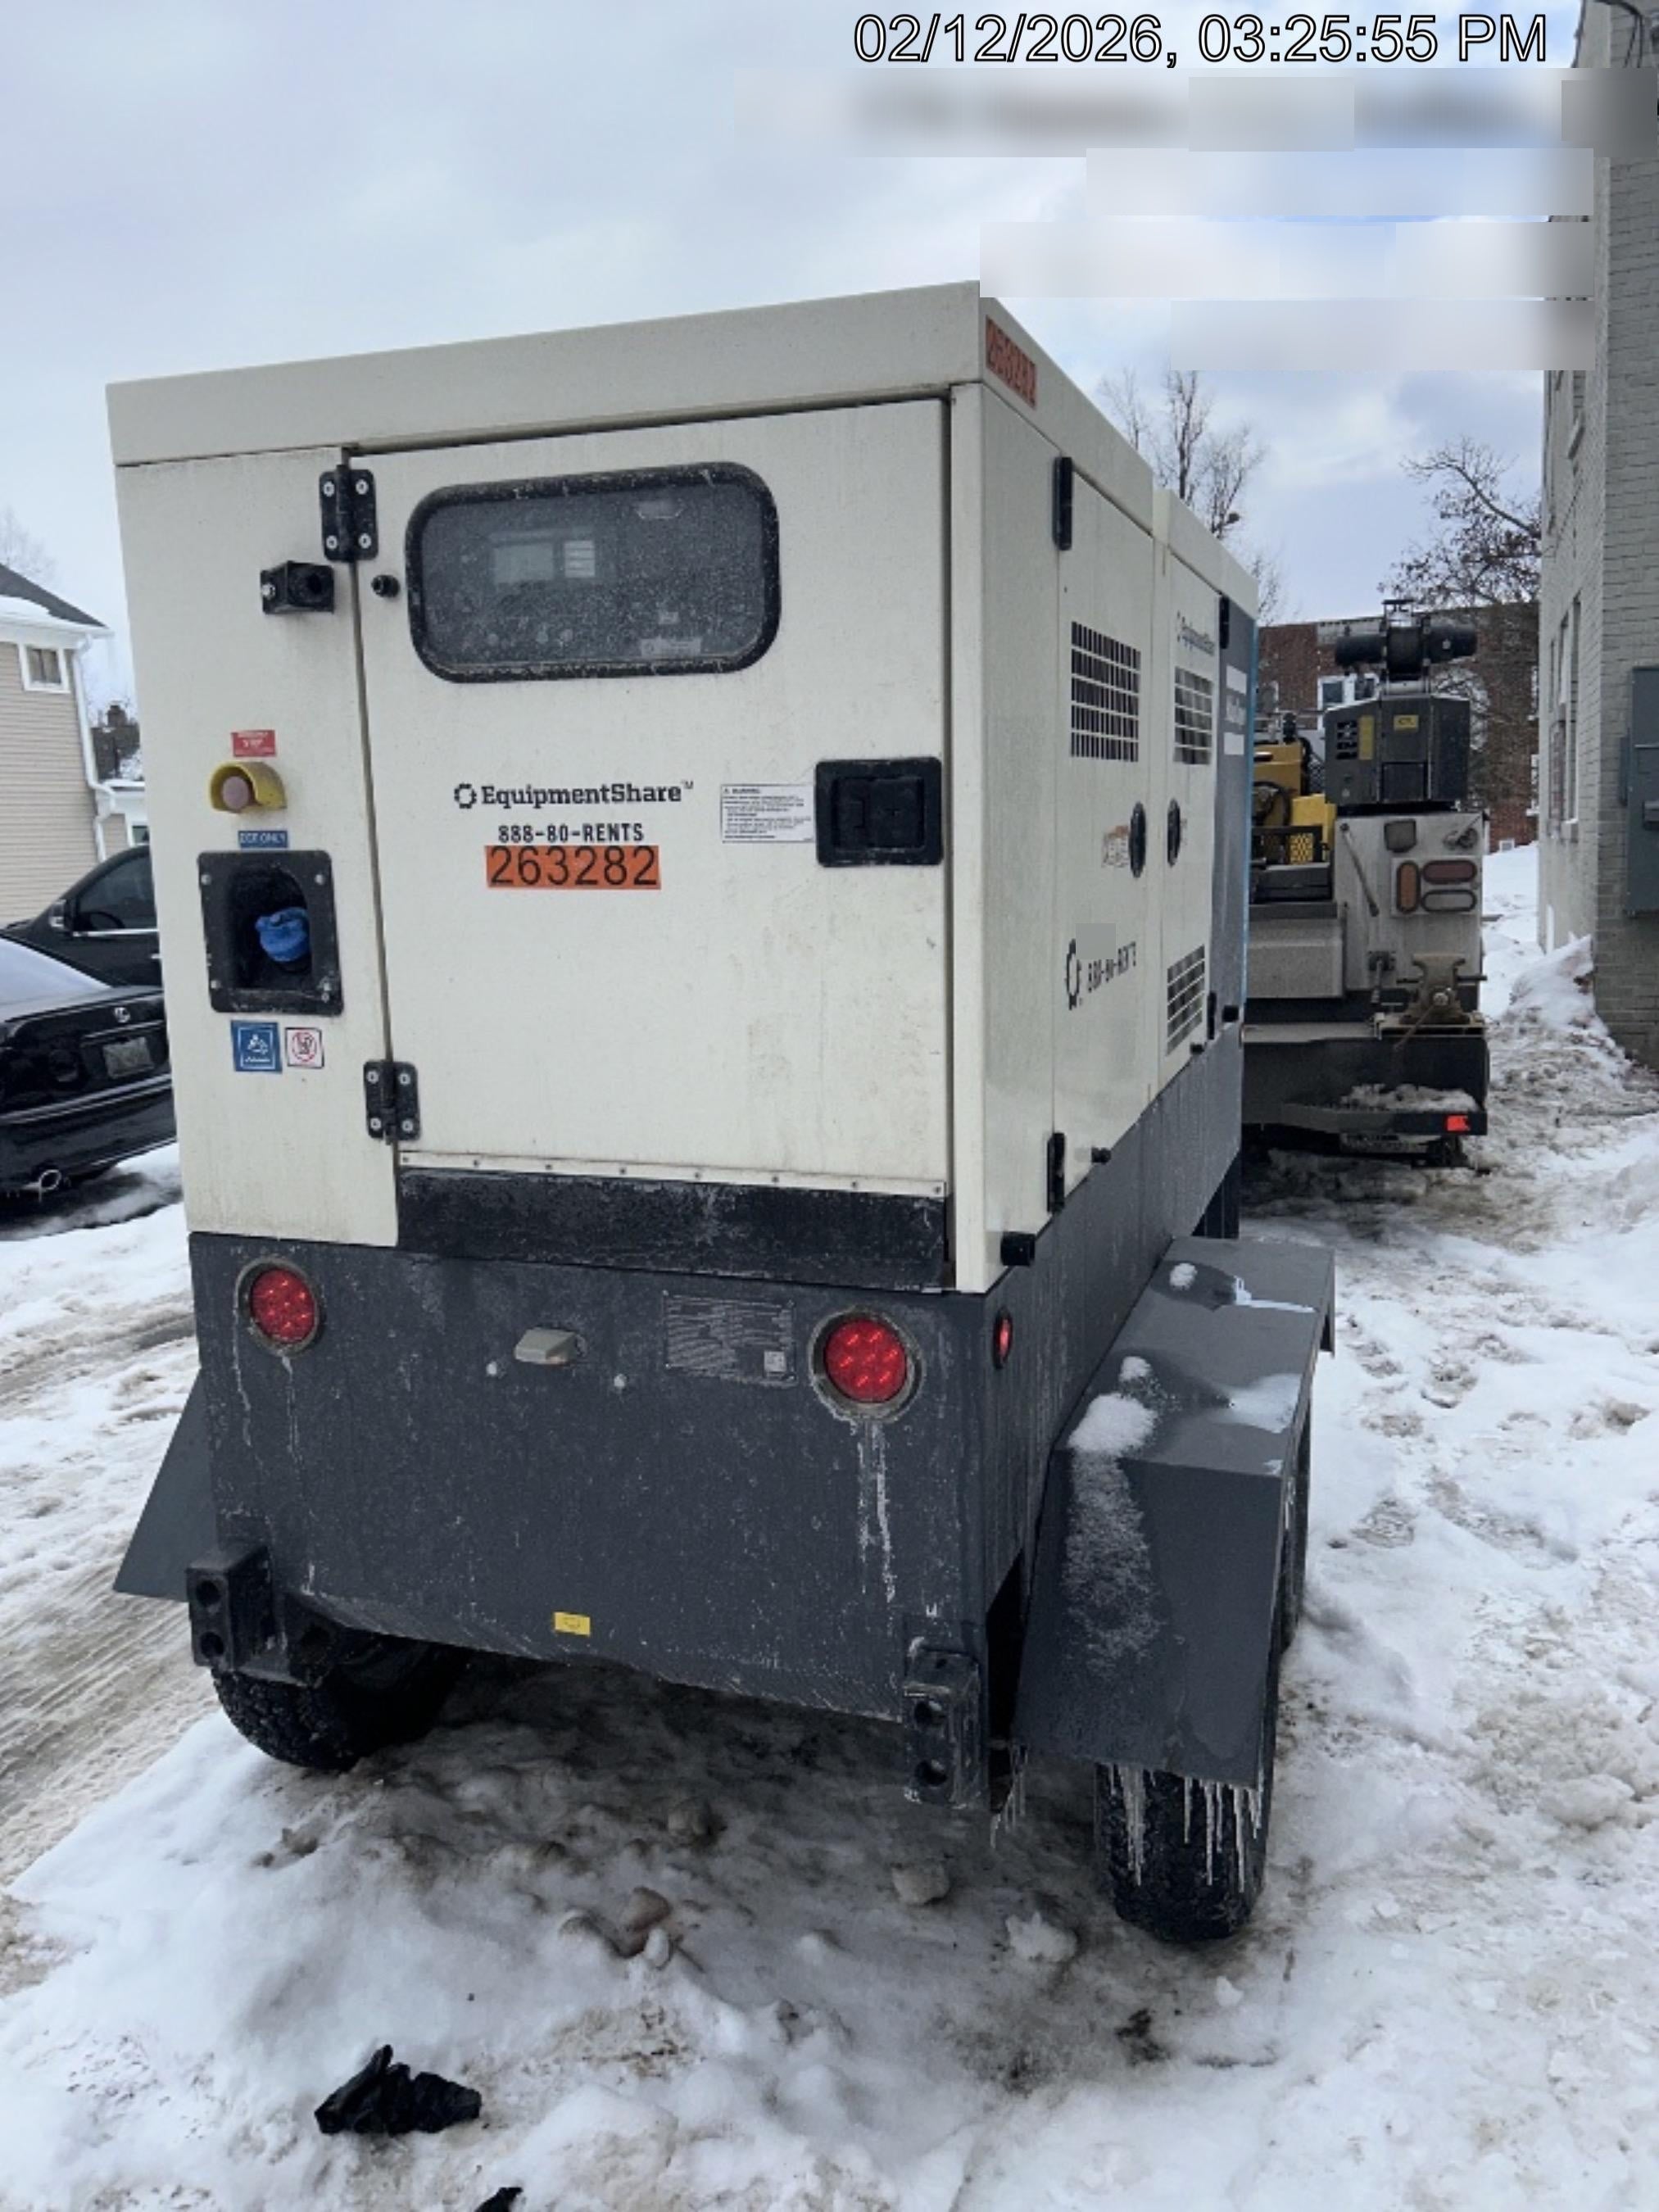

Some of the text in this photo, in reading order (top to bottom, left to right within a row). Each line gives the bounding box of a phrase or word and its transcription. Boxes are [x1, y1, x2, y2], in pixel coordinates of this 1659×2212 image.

[481, 782, 682, 809] EquipmentShare
[498, 823, 645, 844] 888-80-RENTS
[491, 845, 657, 886] 263282
